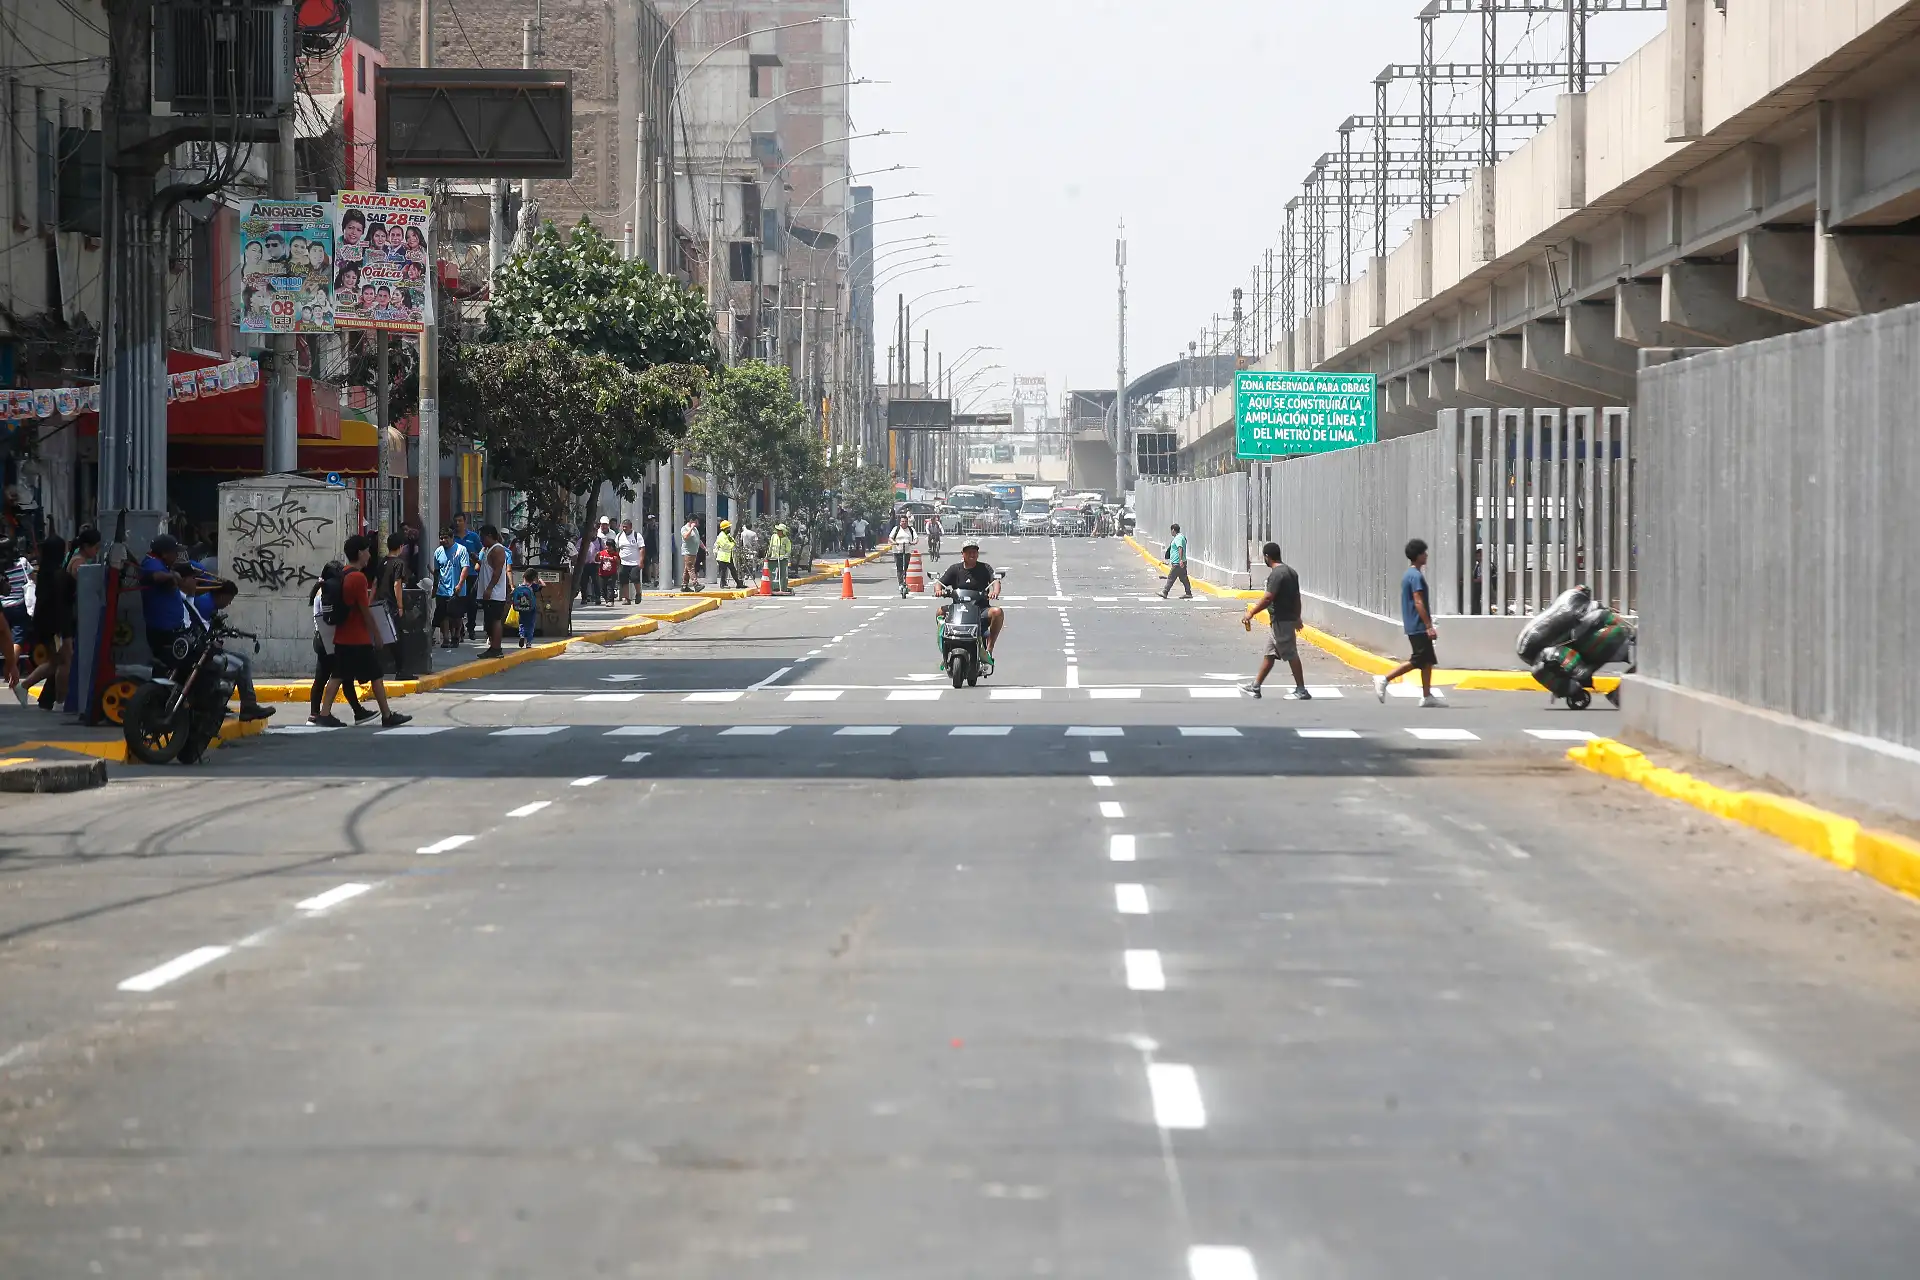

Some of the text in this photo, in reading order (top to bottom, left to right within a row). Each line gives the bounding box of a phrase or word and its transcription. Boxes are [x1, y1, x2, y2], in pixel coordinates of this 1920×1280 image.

[341, 194, 387, 207] SANTA
[389, 197, 426, 209] ROSA
[250, 203, 324, 217] ANGARAES
[367, 213, 387, 222] SAB
[386, 213, 408, 225] 28
[271, 301, 294, 315] 08
[1240, 380, 1370, 393] ZONA RESERVADA PARA OBRAS
[1248, 396, 1272, 409] AQUÍ
[1274, 398, 1285, 409] SE
[1350, 400, 1362, 411] LA
[1245, 411, 1366, 426] AMPLIACIÓN DE LÍNEA 1
[1253, 428, 1358, 442] DEL METRO DE LIMA.
